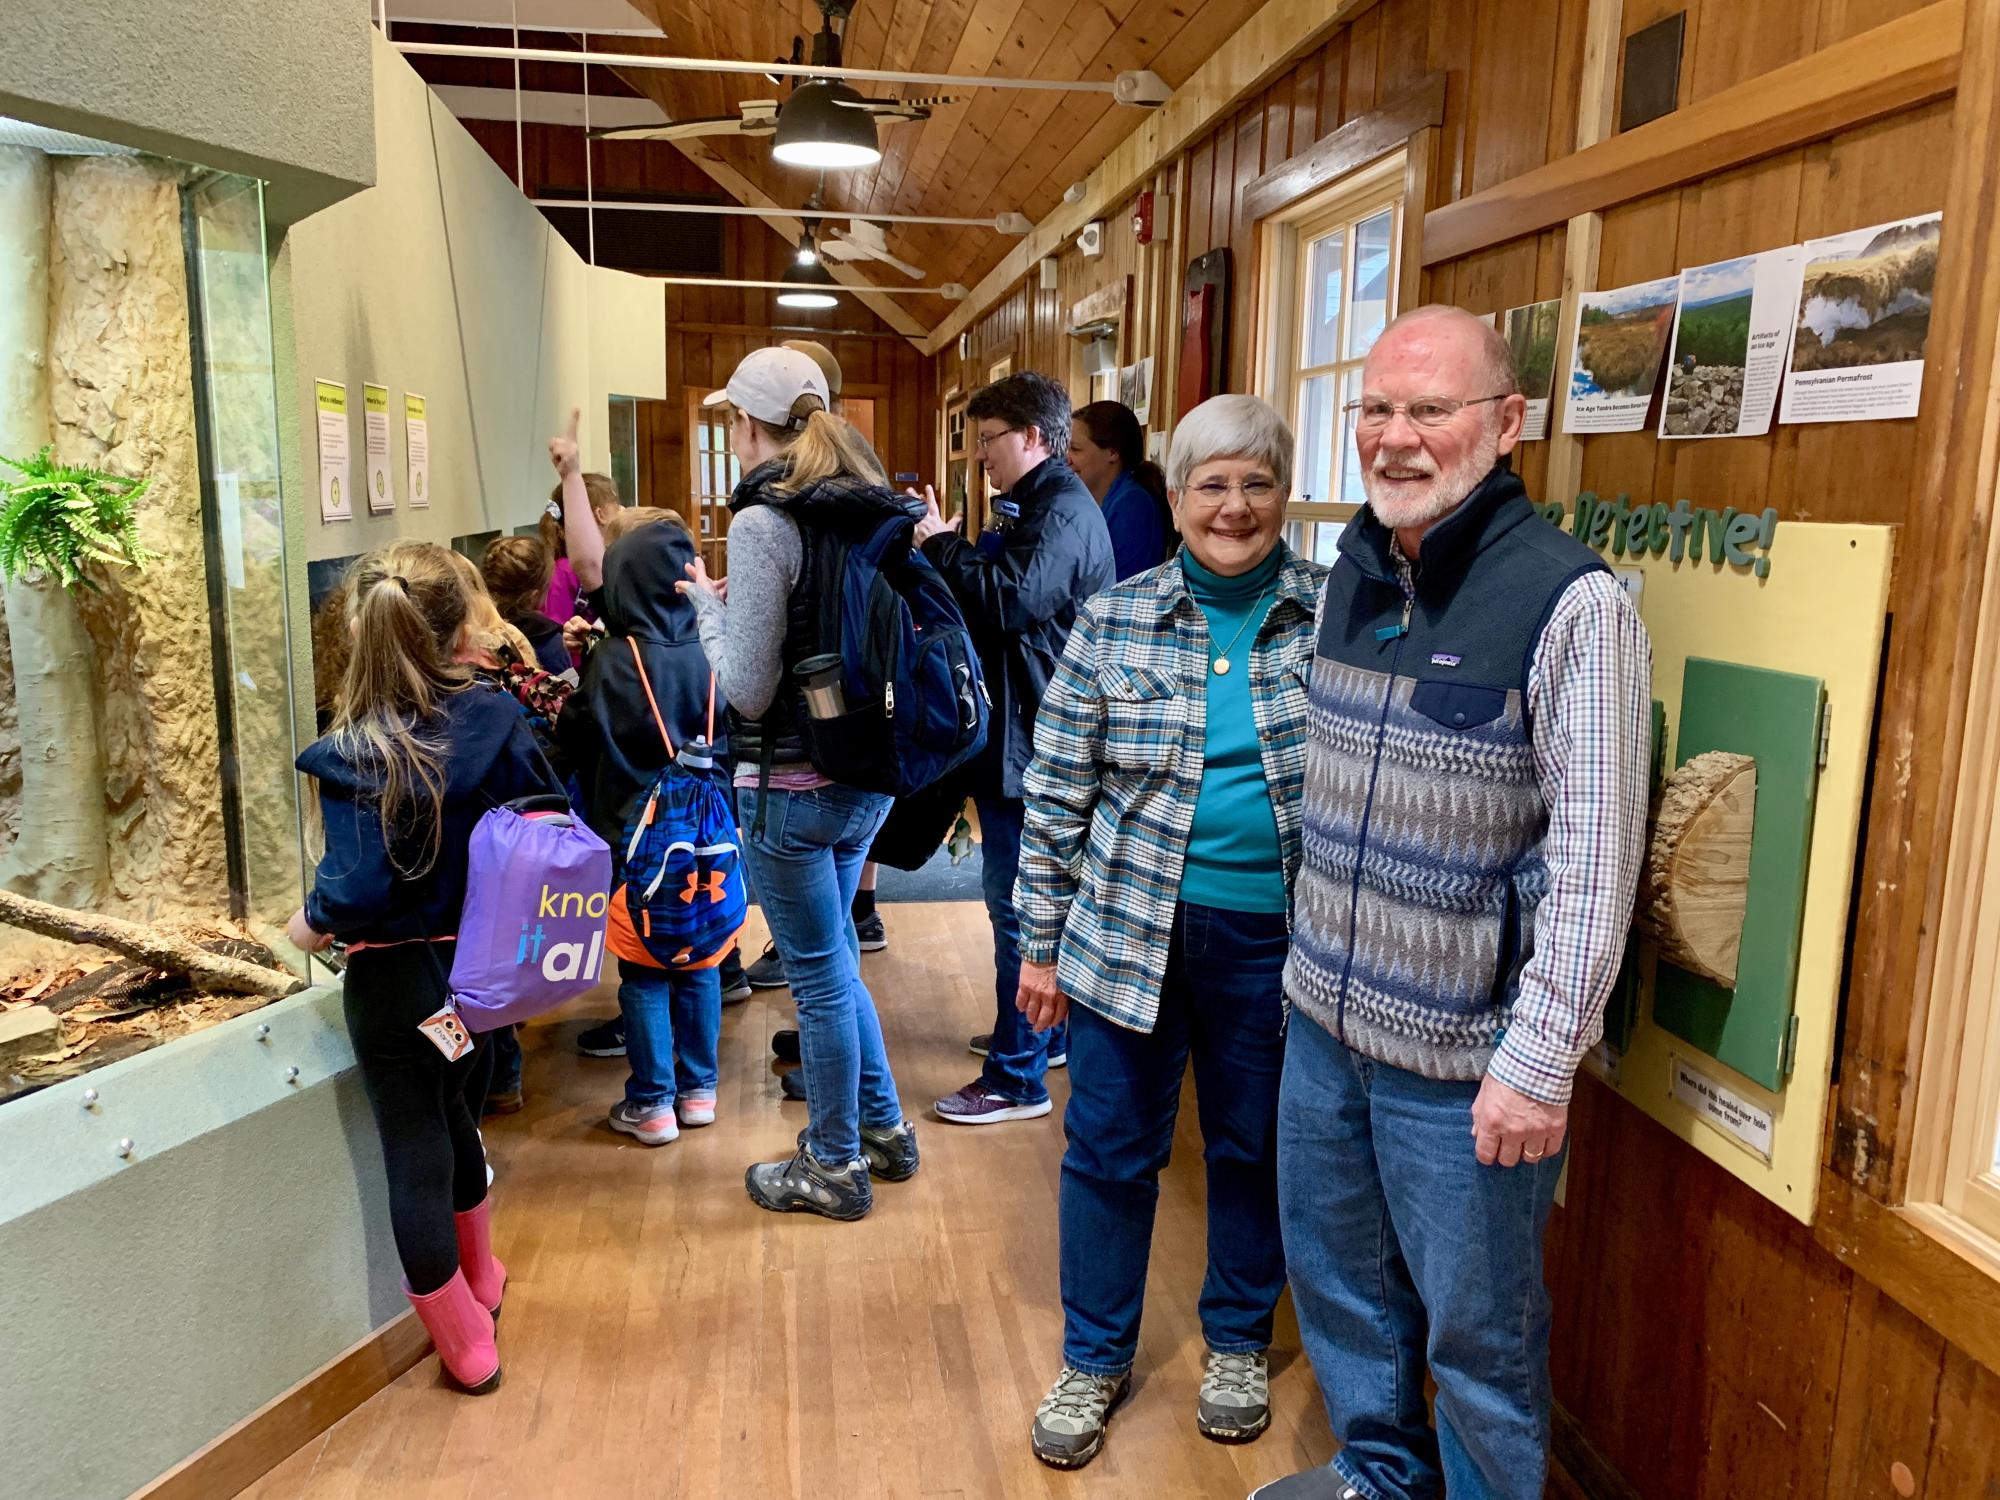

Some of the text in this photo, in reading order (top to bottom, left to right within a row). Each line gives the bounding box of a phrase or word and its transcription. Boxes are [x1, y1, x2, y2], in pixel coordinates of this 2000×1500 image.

[1751, 329, 1781, 341] Artifacts of
[1766, 341, 1776, 349] Age
[1794, 373, 1873, 387] Pennsylvanian Permafrost
[1585, 405, 1596, 413] Age
[538, 884, 608, 919] kno
[516, 923, 604, 983] it al
[1680, 1071, 1697, 1086] Where
[1697, 1083, 1707, 1095] did
[1718, 1095, 1738, 1113] healed
[1738, 1109, 1752, 1123] over
[1753, 1115, 1767, 1131] hole
[1708, 1102, 1742, 1128] come from?
